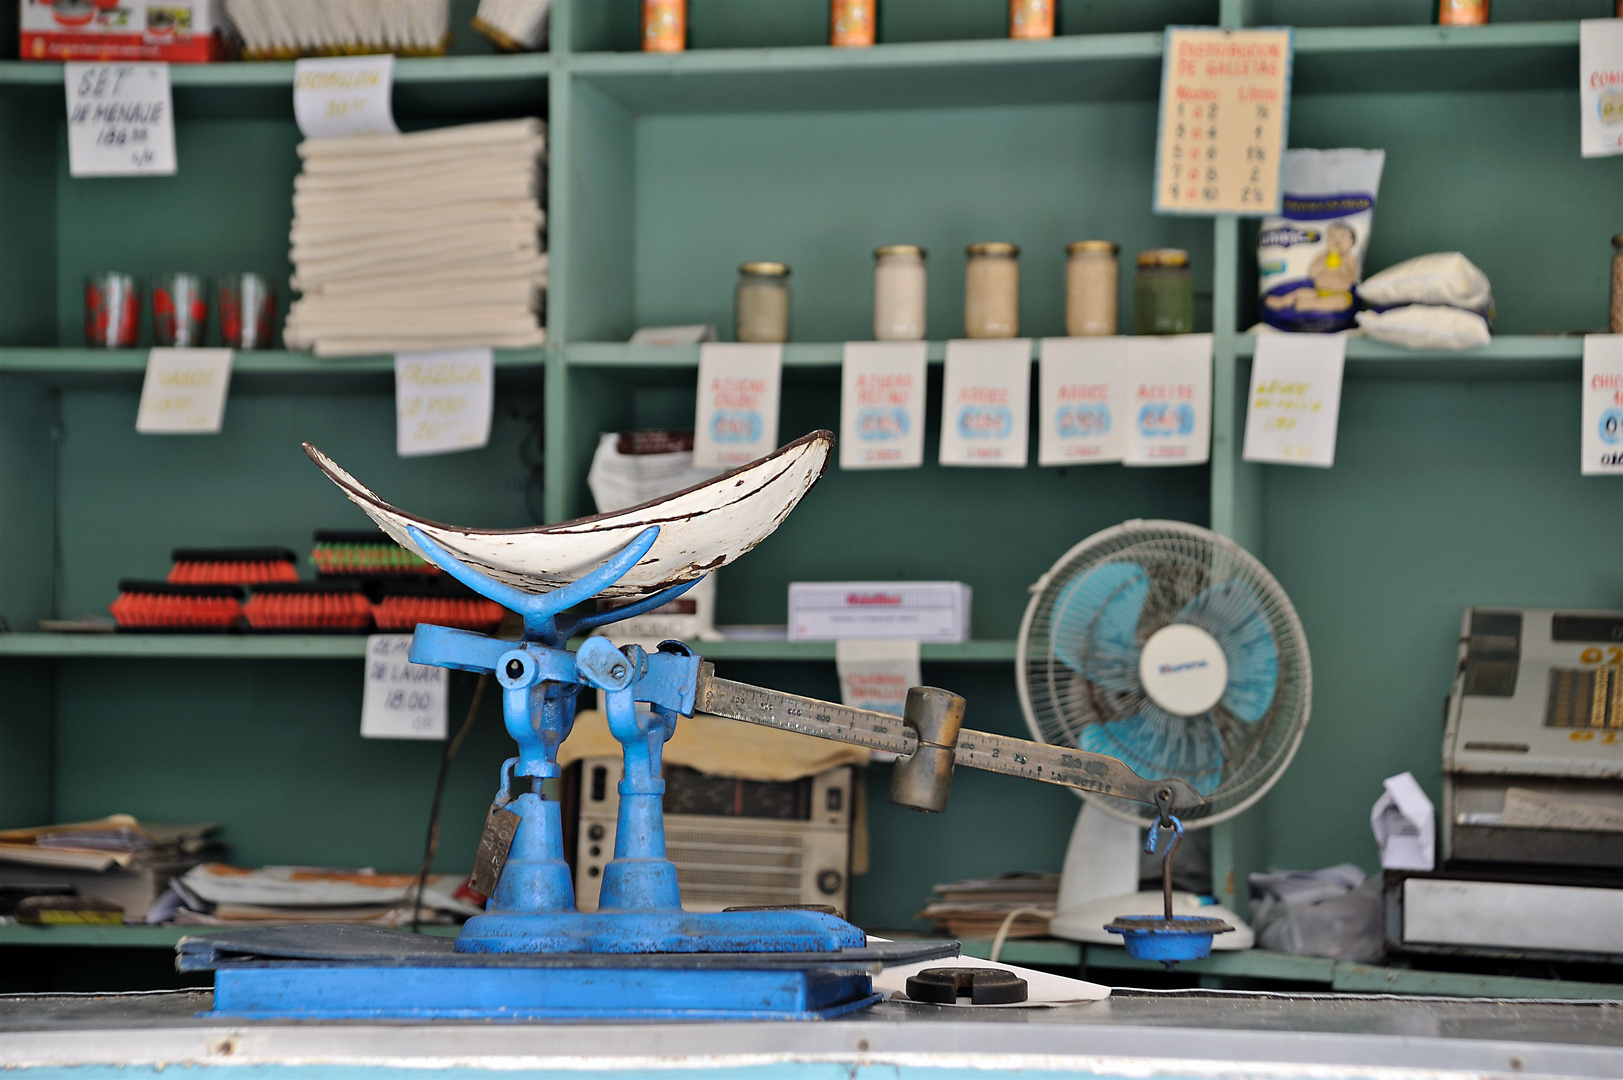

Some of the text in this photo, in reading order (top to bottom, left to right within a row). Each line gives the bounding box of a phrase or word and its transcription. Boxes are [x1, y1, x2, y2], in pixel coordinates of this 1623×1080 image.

[1177, 58, 1278, 77] DE GALLETAS
[78, 66, 135, 98] SET
[1590, 71, 1623, 88] COM
[71, 101, 164, 123] DE MENAJE
[855, 373, 914, 390] AZUCAR
[957, 385, 1010, 405] ARROZ
[1056, 383, 1110, 402] ARROZ
[1136, 383, 1195, 402] ACEITE
[391, 661, 442, 682] LAVAR
[873, 724, 888, 734] 200
[991, 747, 1001, 758] 2
